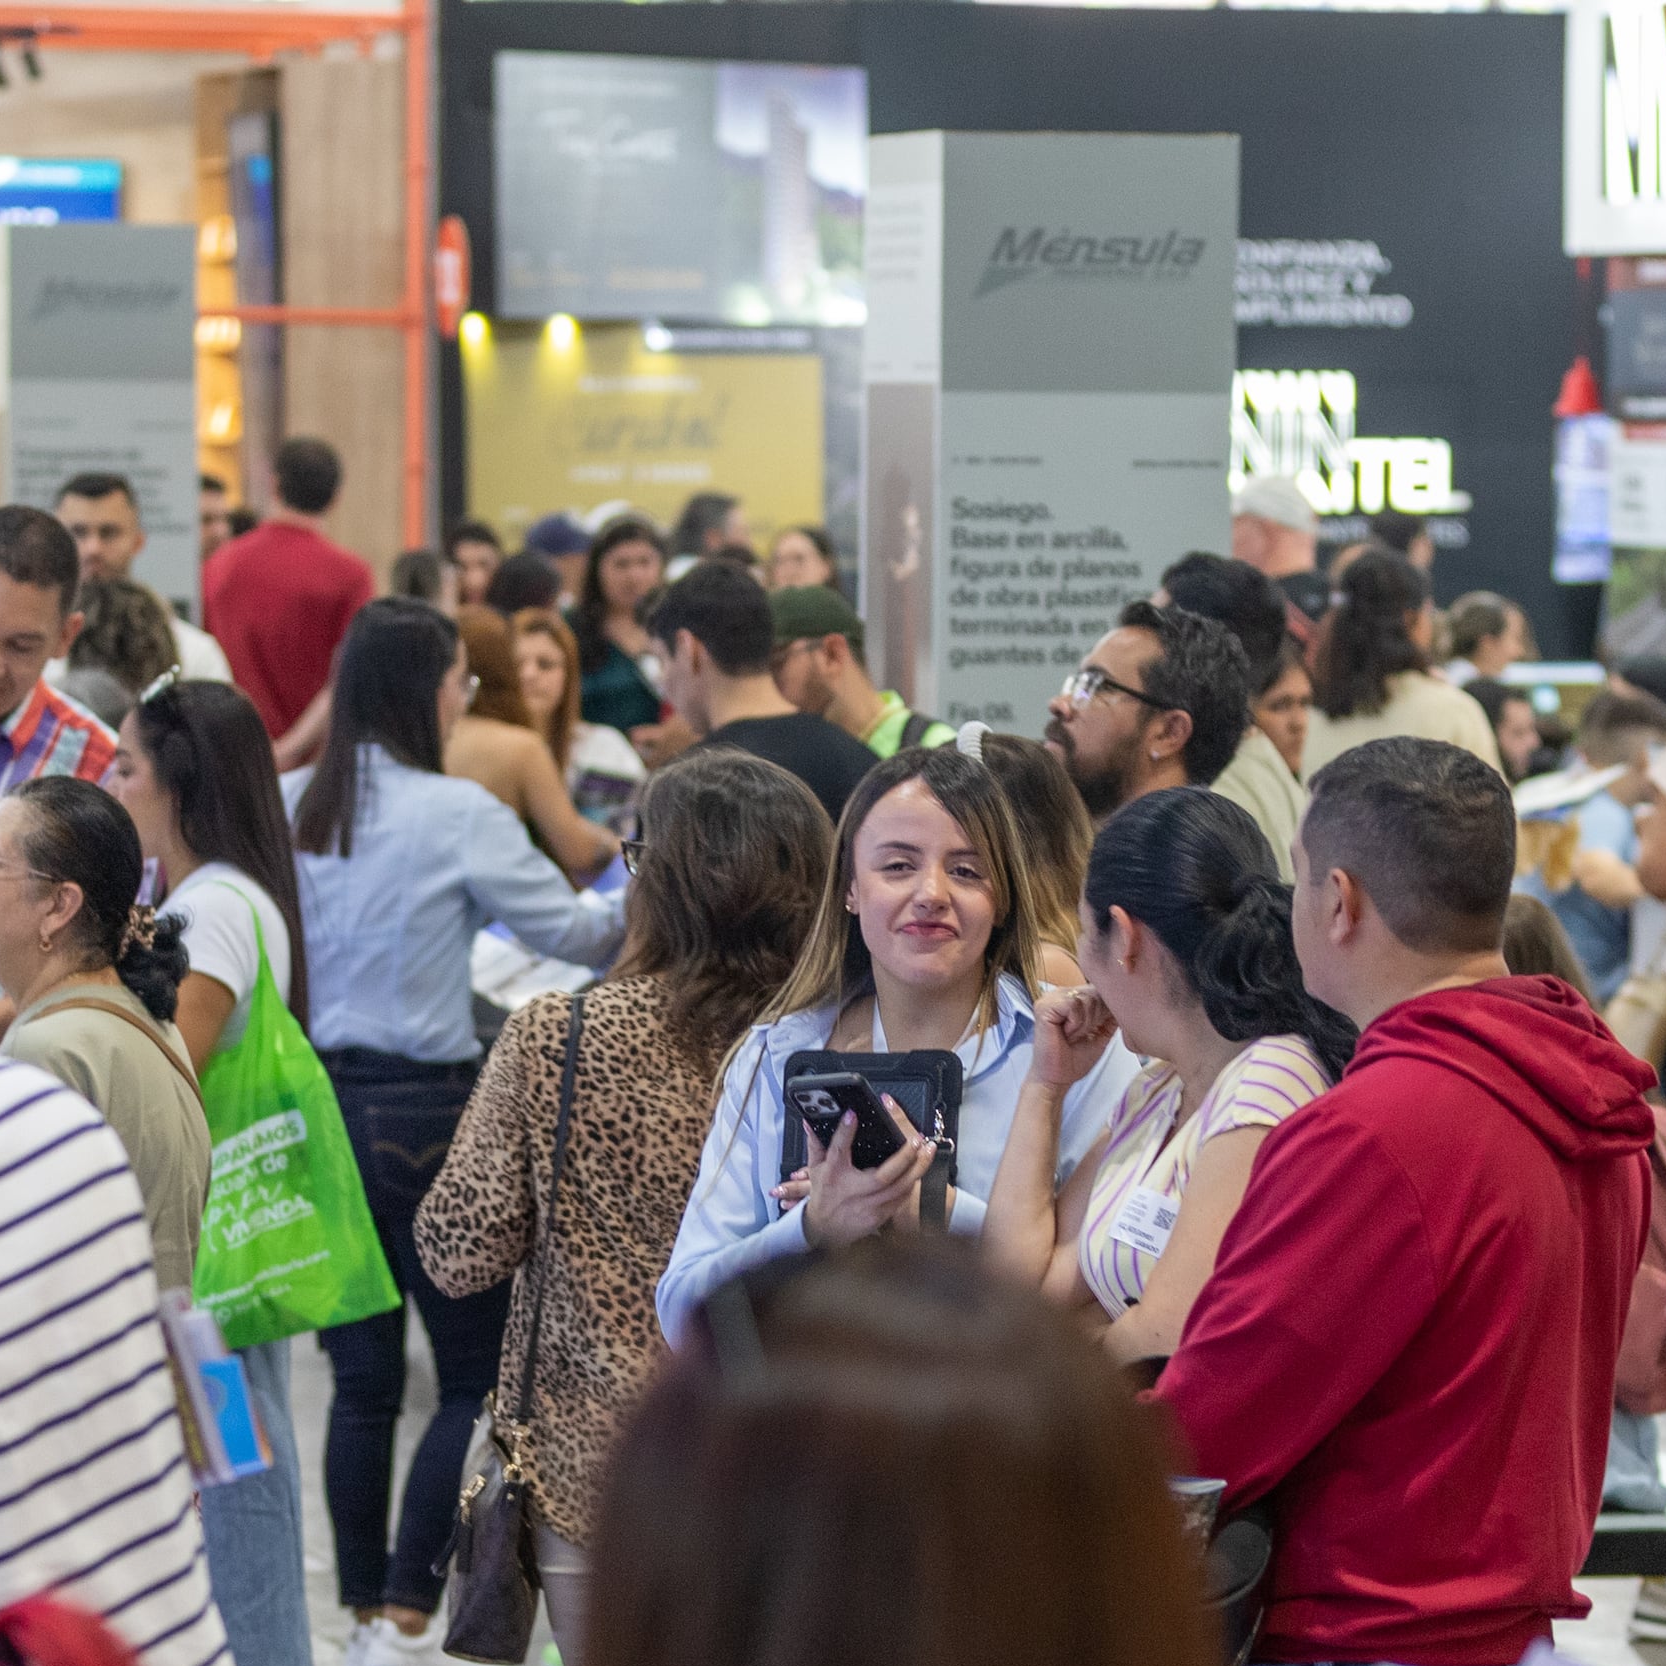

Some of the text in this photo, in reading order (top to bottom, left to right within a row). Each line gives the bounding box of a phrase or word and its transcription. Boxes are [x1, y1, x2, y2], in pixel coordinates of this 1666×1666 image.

[989, 227, 1206, 266] Ménsula
[951, 497, 1052, 524] Sosiego.
[951, 526, 1127, 550] Base en arcilla,
[950, 556, 1141, 582] figura de planos
[950, 586, 979, 606] de
[985, 586, 1039, 606] obra
[950, 615, 1073, 635] terminada
[950, 646, 1045, 668] guantes
